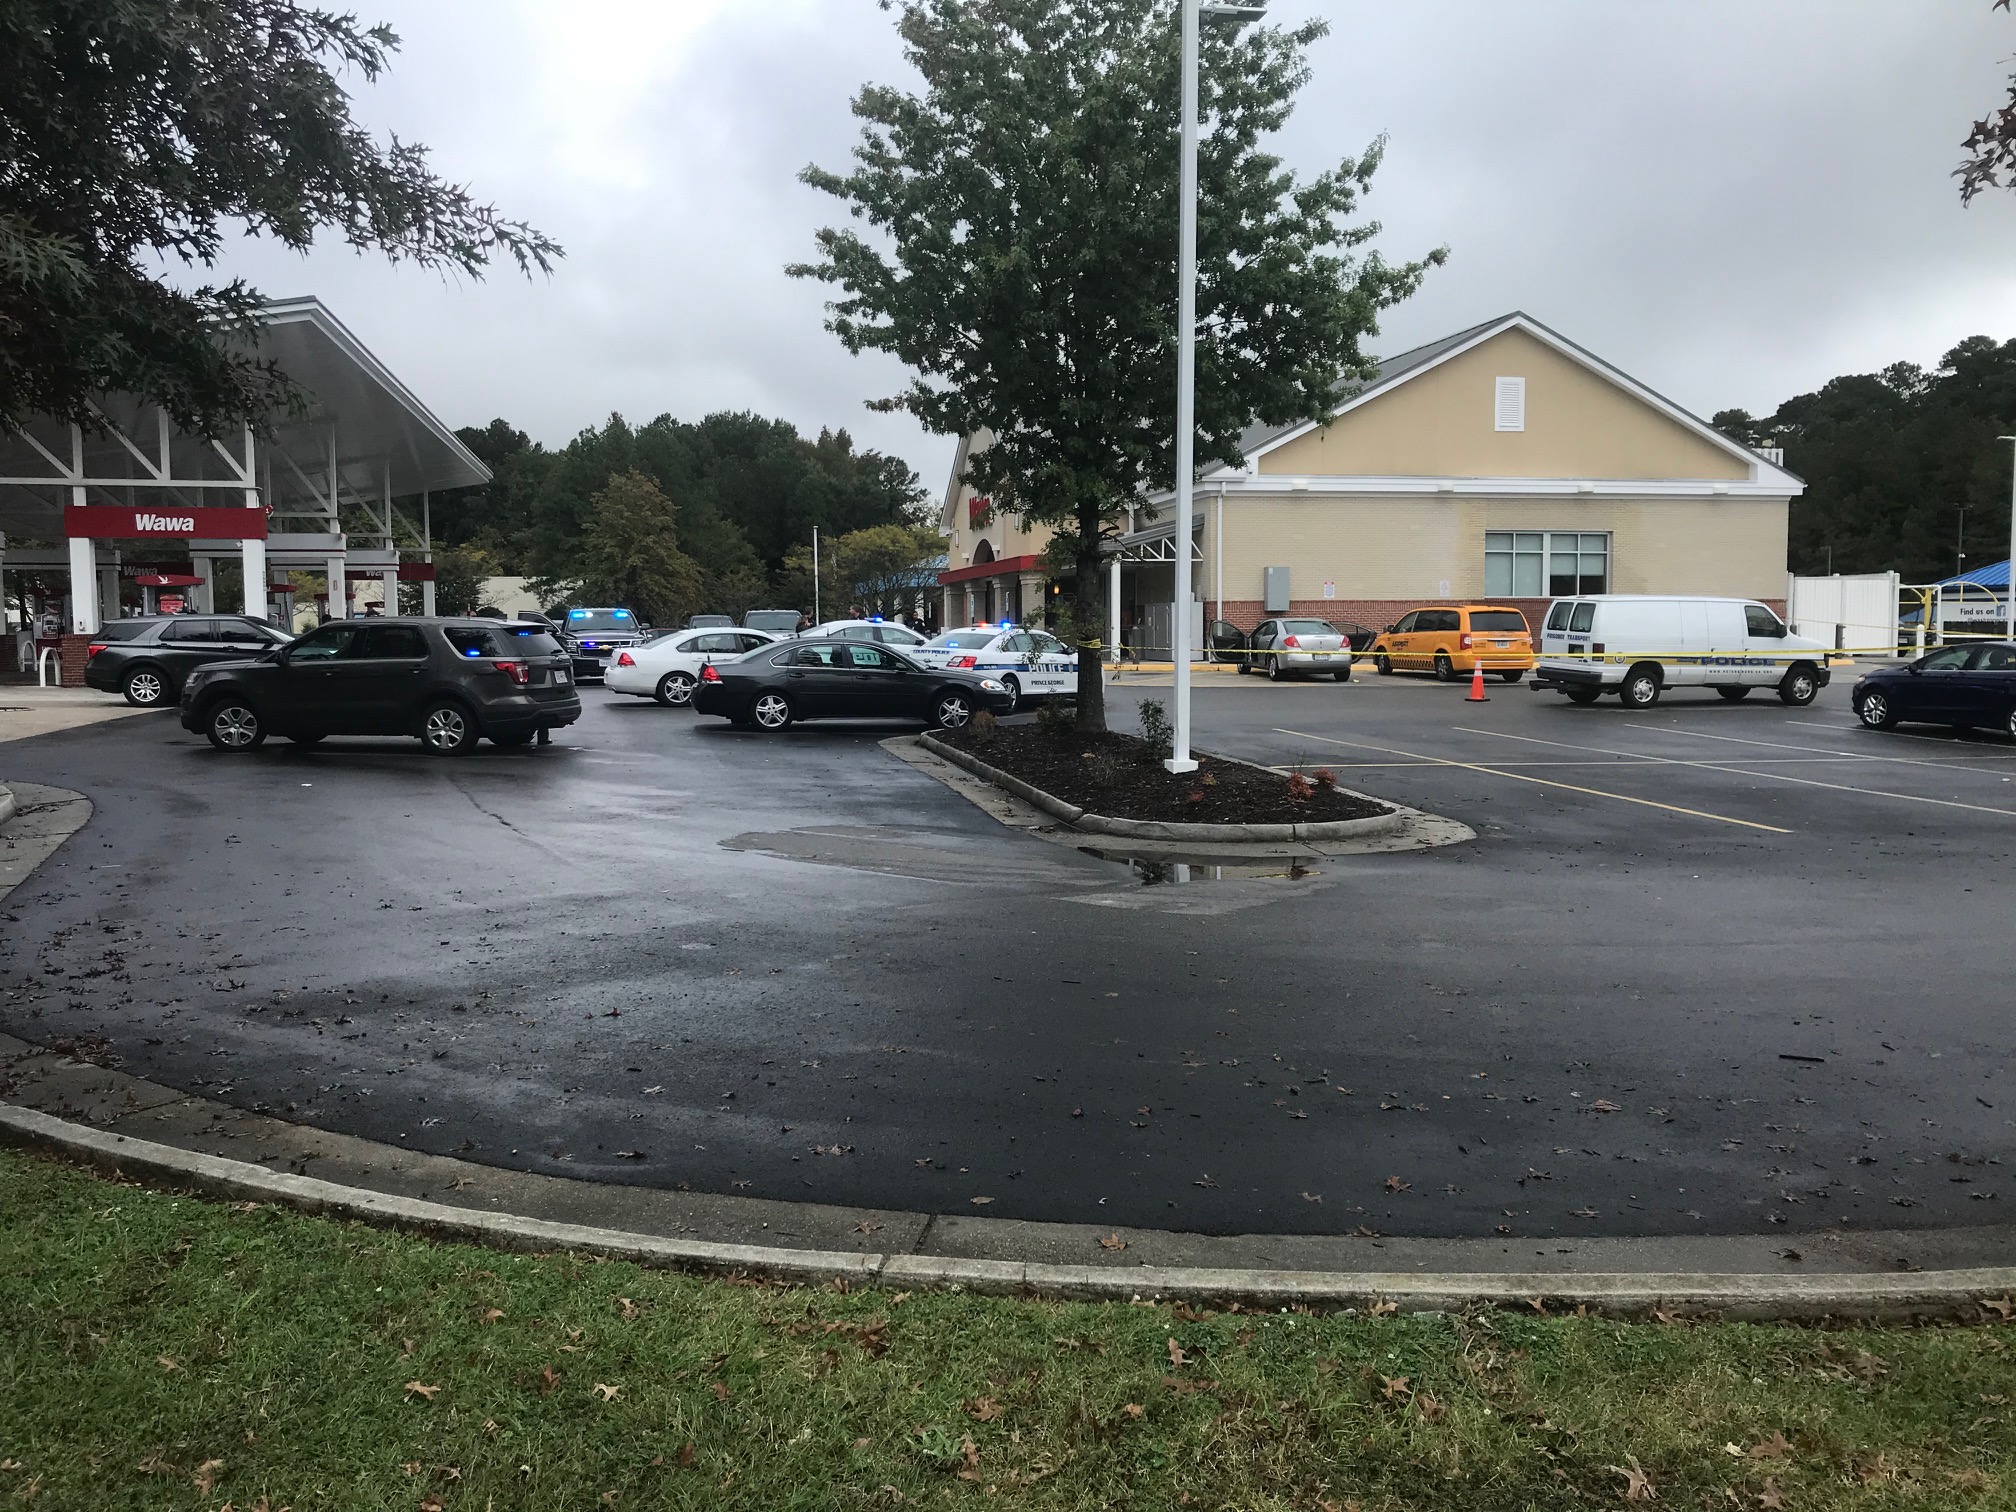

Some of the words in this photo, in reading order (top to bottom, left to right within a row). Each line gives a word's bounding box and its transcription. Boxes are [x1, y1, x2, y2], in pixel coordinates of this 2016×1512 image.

[135, 513, 195, 532] Wawa
[124, 565, 158, 576] Wawa
[1960, 607, 1974, 615] Find
[1028, 663, 1065, 674] POLICE
